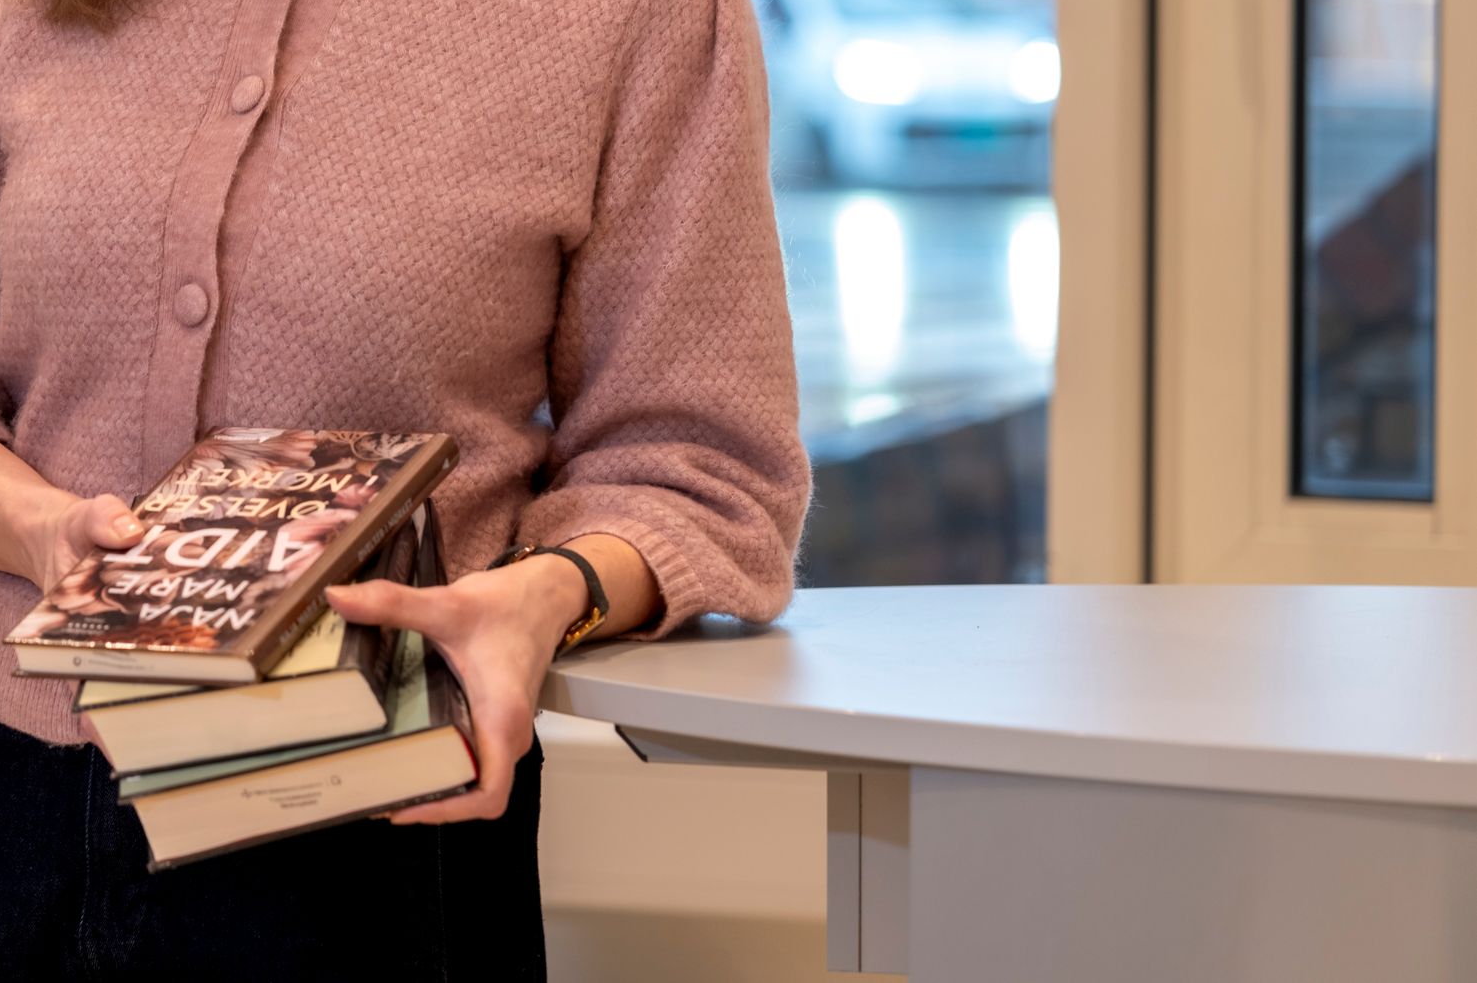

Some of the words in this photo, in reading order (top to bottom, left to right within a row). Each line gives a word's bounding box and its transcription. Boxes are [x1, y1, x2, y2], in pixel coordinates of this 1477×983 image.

[137, 493, 331, 521] ØVELSER
[103, 524, 326, 572] AIDT
[108, 572, 249, 601] MARIE
[139, 602, 258, 631] NAJA
